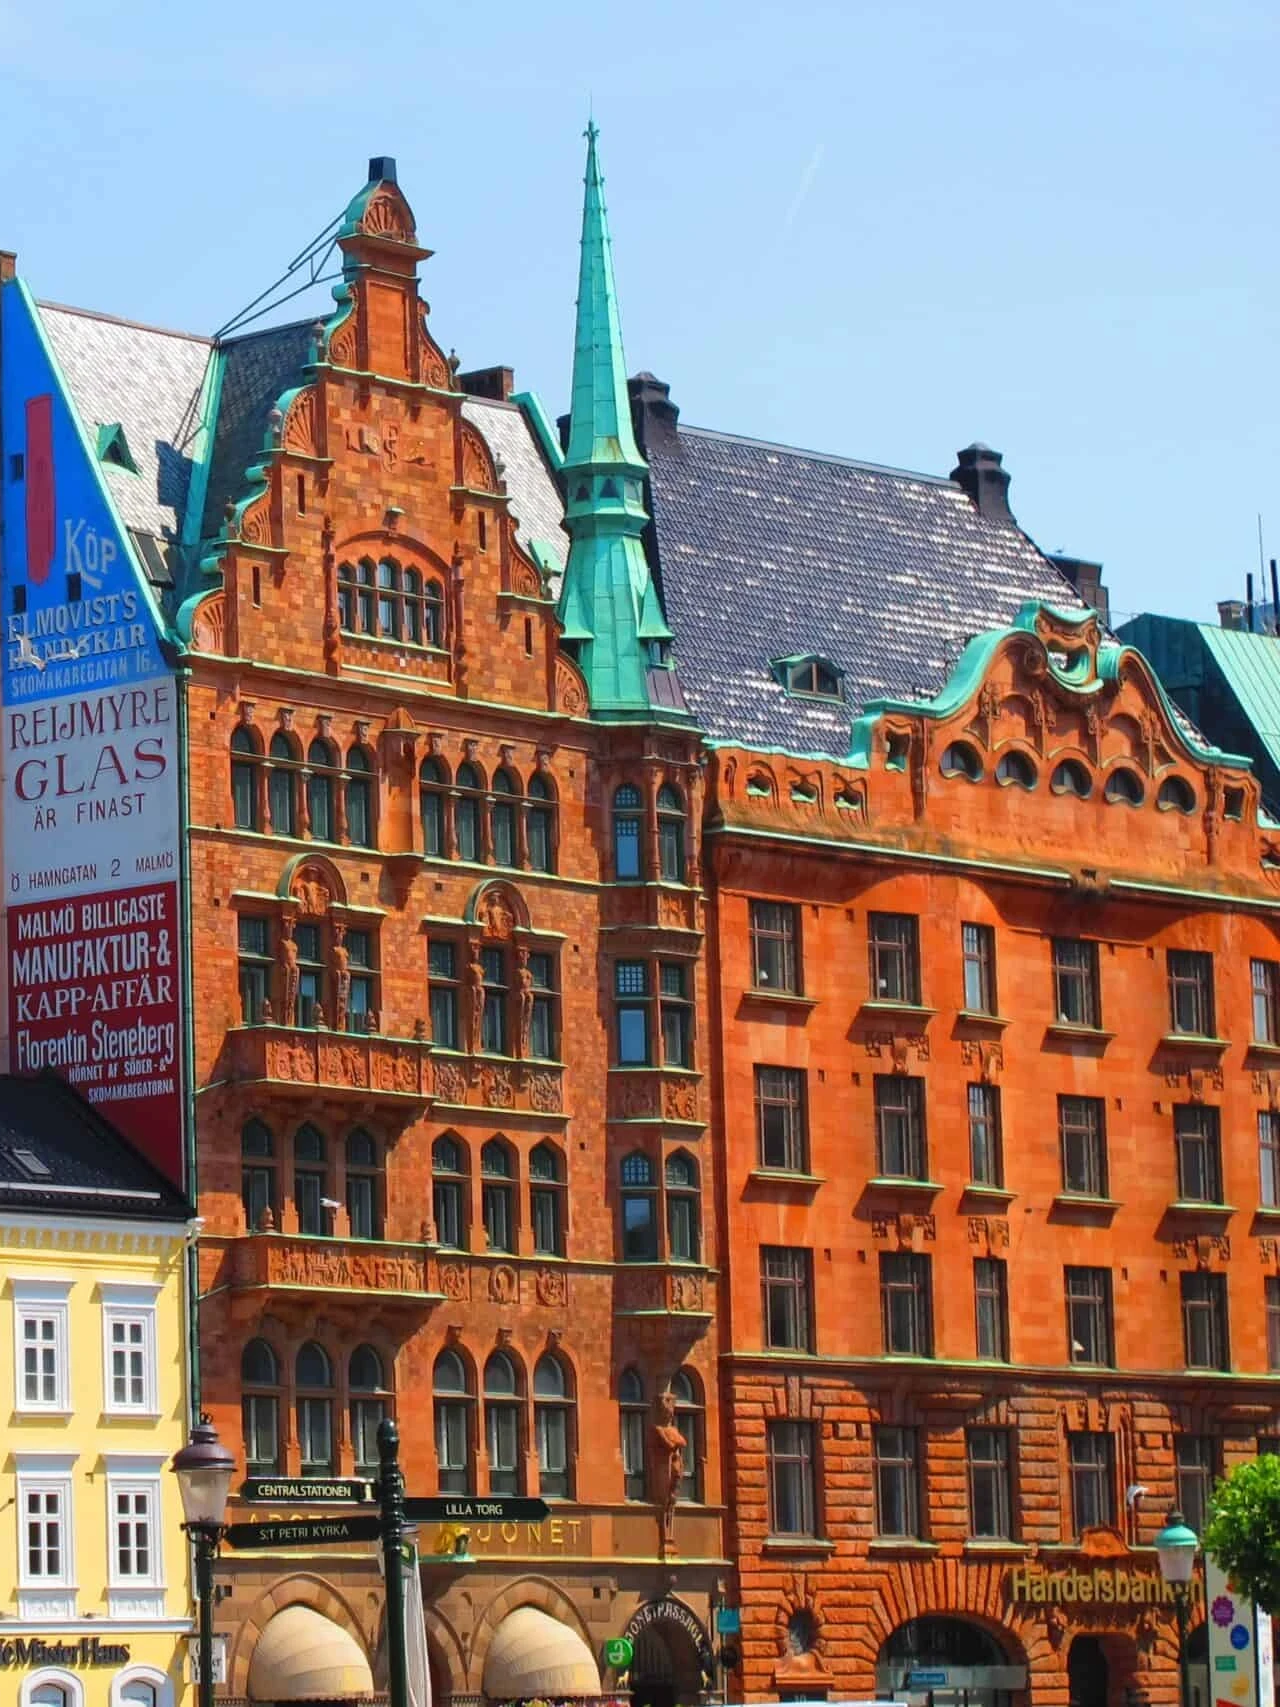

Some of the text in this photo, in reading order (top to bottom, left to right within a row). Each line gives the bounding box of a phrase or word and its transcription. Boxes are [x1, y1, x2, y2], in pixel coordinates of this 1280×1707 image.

[64, 517, 118, 591] KÖP
[11, 657, 129, 698] SKOMAKAREGATAN
[9, 685, 171, 750] REIJMYRE
[13, 736, 169, 802] GLAS
[32, 792, 147, 833] ÄR FINAST
[28, 863, 98, 889] HAMNGATAN
[110, 857, 122, 879] 2
[135, 848, 174, 873] MALMÖ
[17, 893, 166, 941] MALMÖ BILLIGASTE
[15, 973, 174, 1023] KAPP-AFFÄR
[16, 1014, 175, 1071] Florentin Steneberg
[257, 1484, 352, 1498] CENTRALSTATIONEN
[445, 1503, 504, 1516] LILLA TORG
[278, 1526, 309, 1539] PETRI
[312, 1523, 350, 1537] KYRKA
[79, 1636, 131, 1666] Hans
